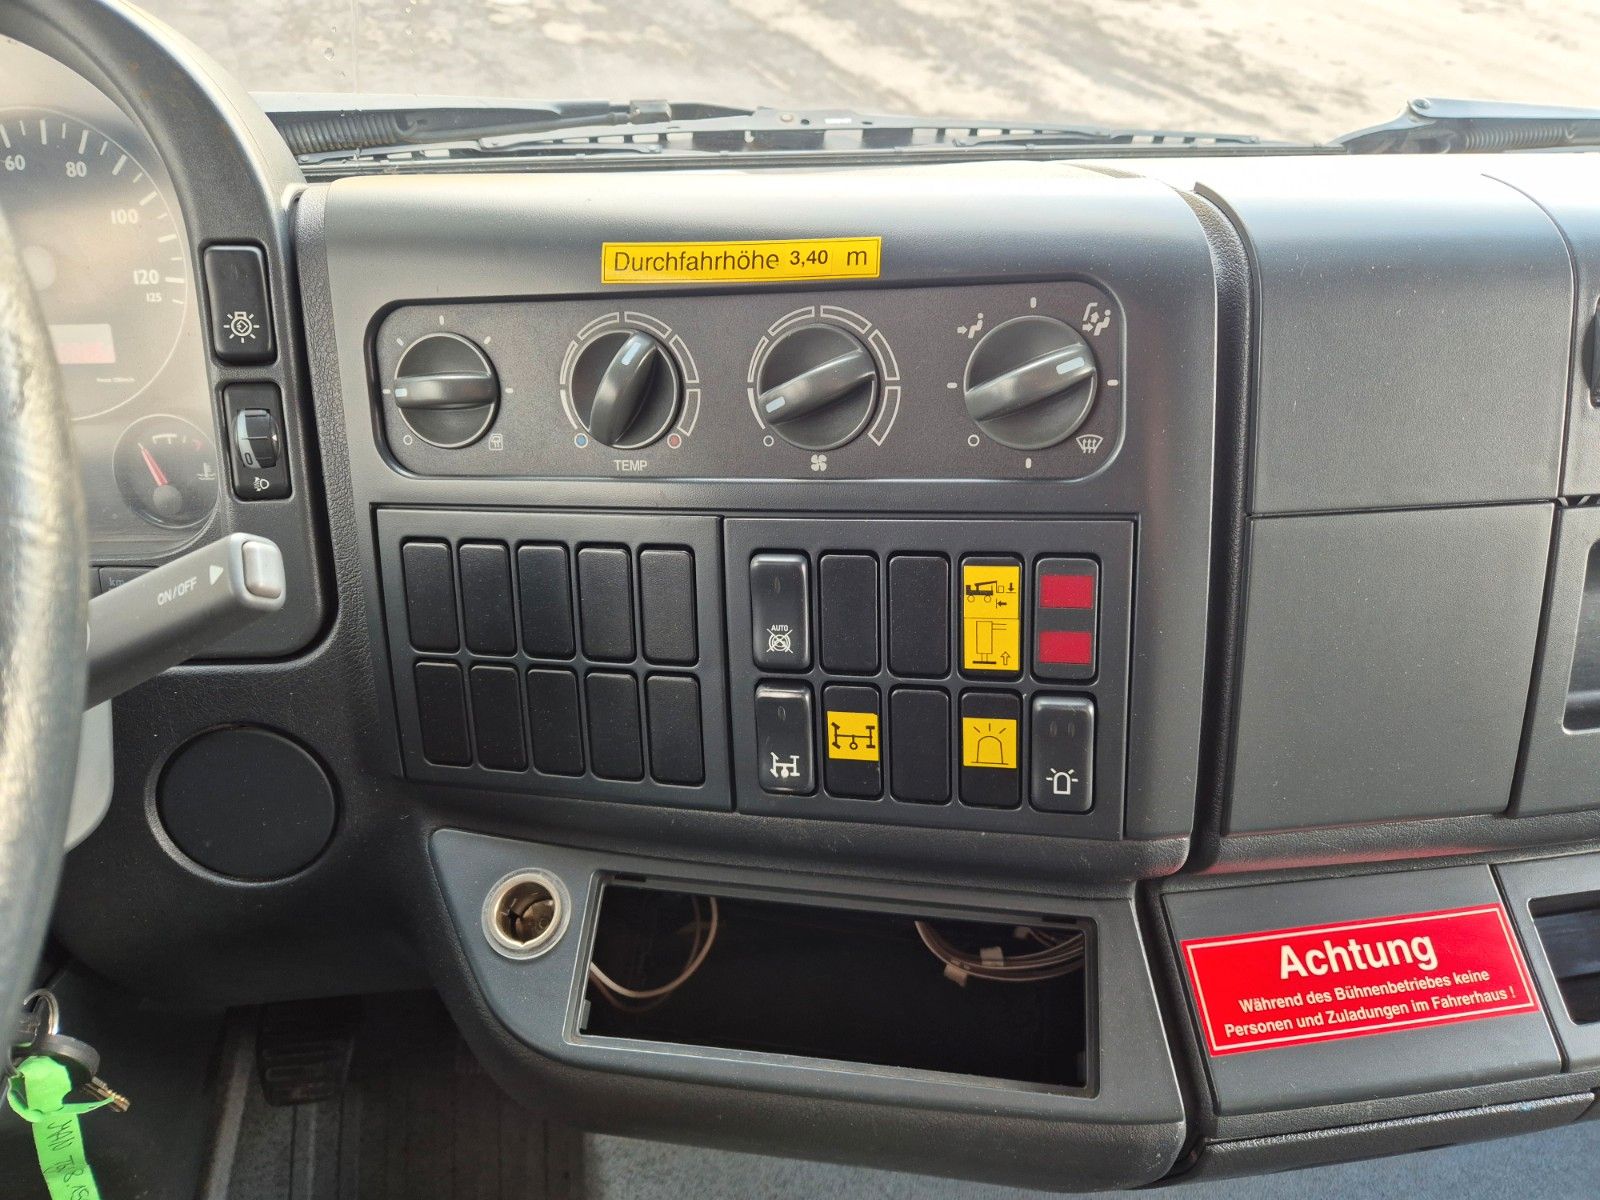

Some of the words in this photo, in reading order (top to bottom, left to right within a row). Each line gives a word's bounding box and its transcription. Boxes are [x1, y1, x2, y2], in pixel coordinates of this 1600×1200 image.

[4, 154, 26, 171] 60
[65, 161, 88, 178] 80
[110, 208, 139, 225] 100
[614, 251, 779, 272] Durchfahrhöhe
[789, 249, 829, 267] 3,40
[846, 250, 868, 266] m
[133, 269, 160, 285] 120
[146, 292, 162, 302] 125
[613, 459, 648, 472] TEMP
[157, 576, 198, 606] ON/OFF
[770, 624, 789, 632] AUTO
[1279, 935, 1439, 980] Achtung
[1239, 993, 1302, 1014] Während
[1306, 991, 1332, 1005] des
[1334, 976, 1452, 1001] Bühnenbetriebes
[1453, 968, 1490, 985] keine
[1224, 1017, 1294, 1038] Personen
[1296, 1012, 1324, 1028] und
[1327, 1001, 1410, 1025] Zuladungen
[1412, 999, 1430, 1014] im
[1432, 988, 1508, 1010] Fahrerhaus
